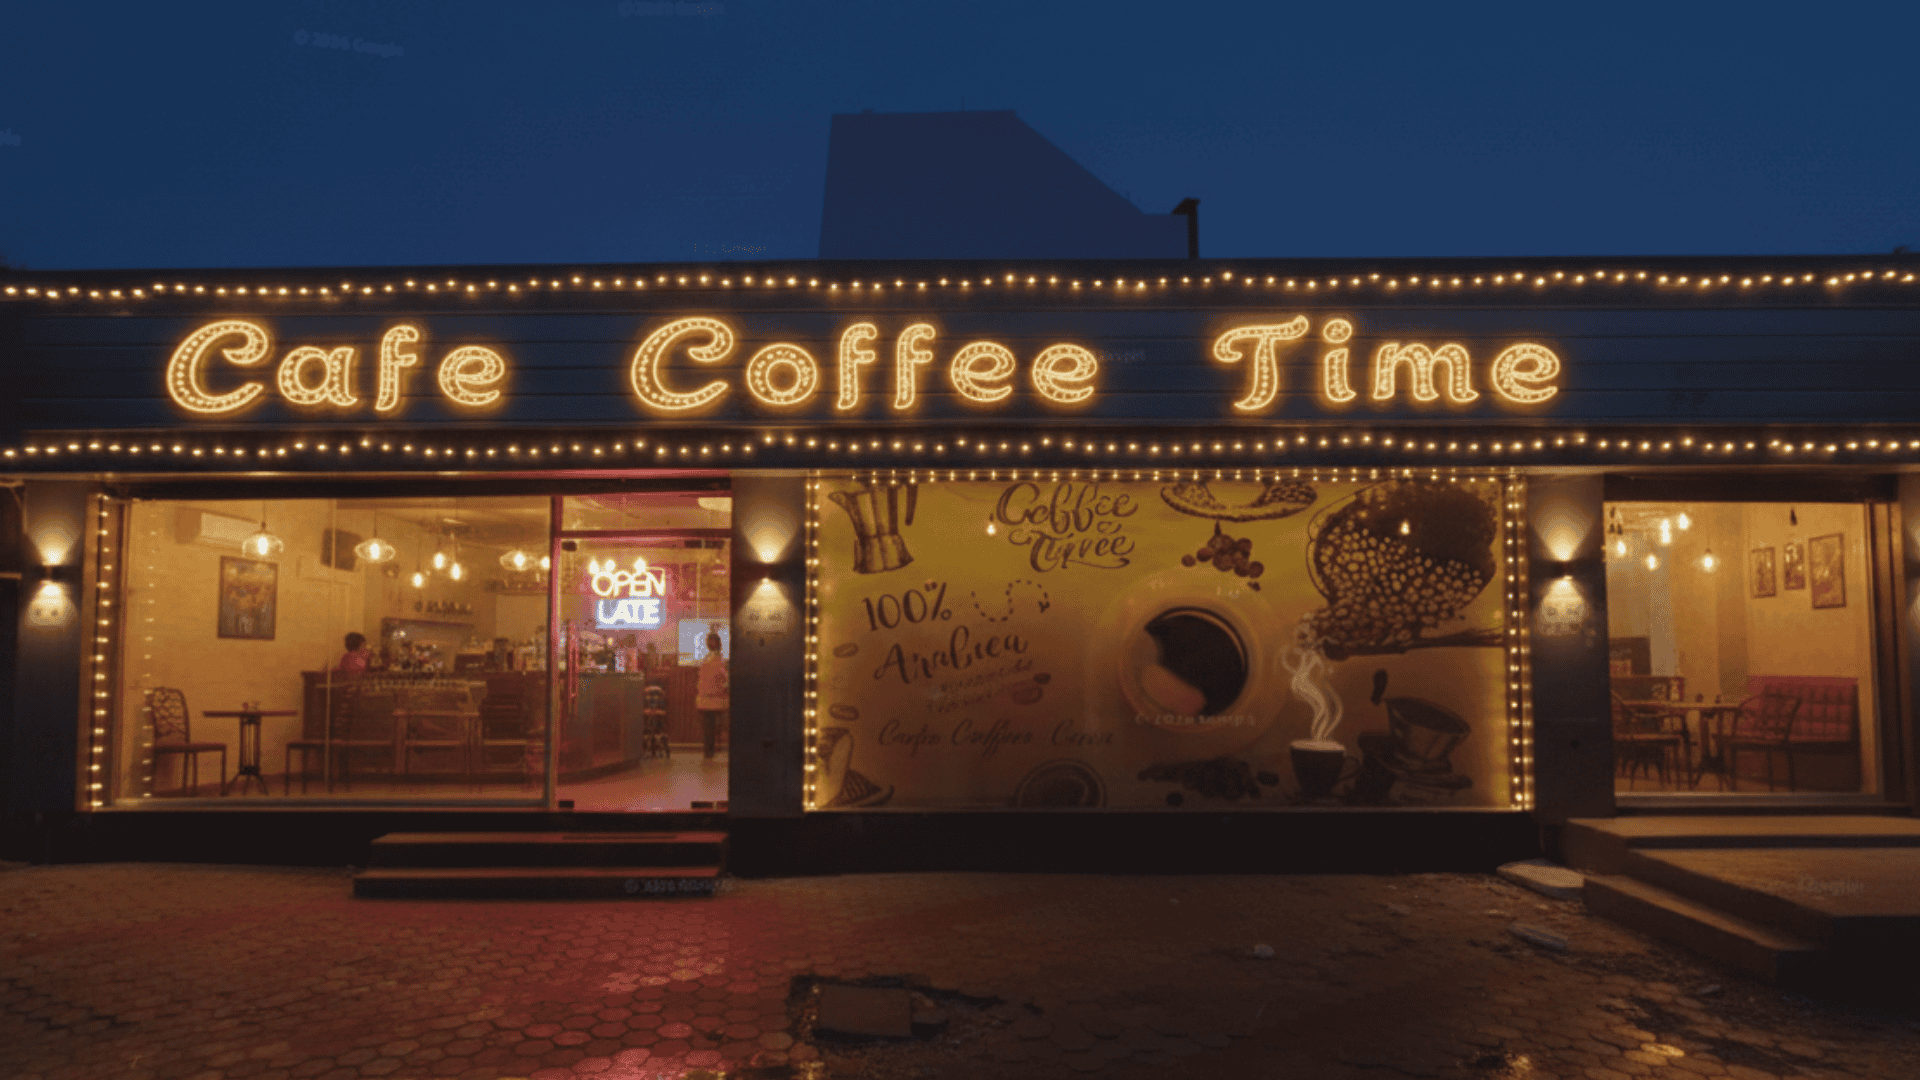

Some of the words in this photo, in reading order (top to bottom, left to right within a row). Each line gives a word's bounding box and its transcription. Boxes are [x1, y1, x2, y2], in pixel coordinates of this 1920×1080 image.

[166, 320, 506, 413] Cafe
[630, 316, 1098, 411] Coffee
[1213, 314, 1561, 411] Time
[591, 567, 667, 597] OPEN
[597, 598, 661, 626] LATE
[862, 581, 952, 631] 100%
